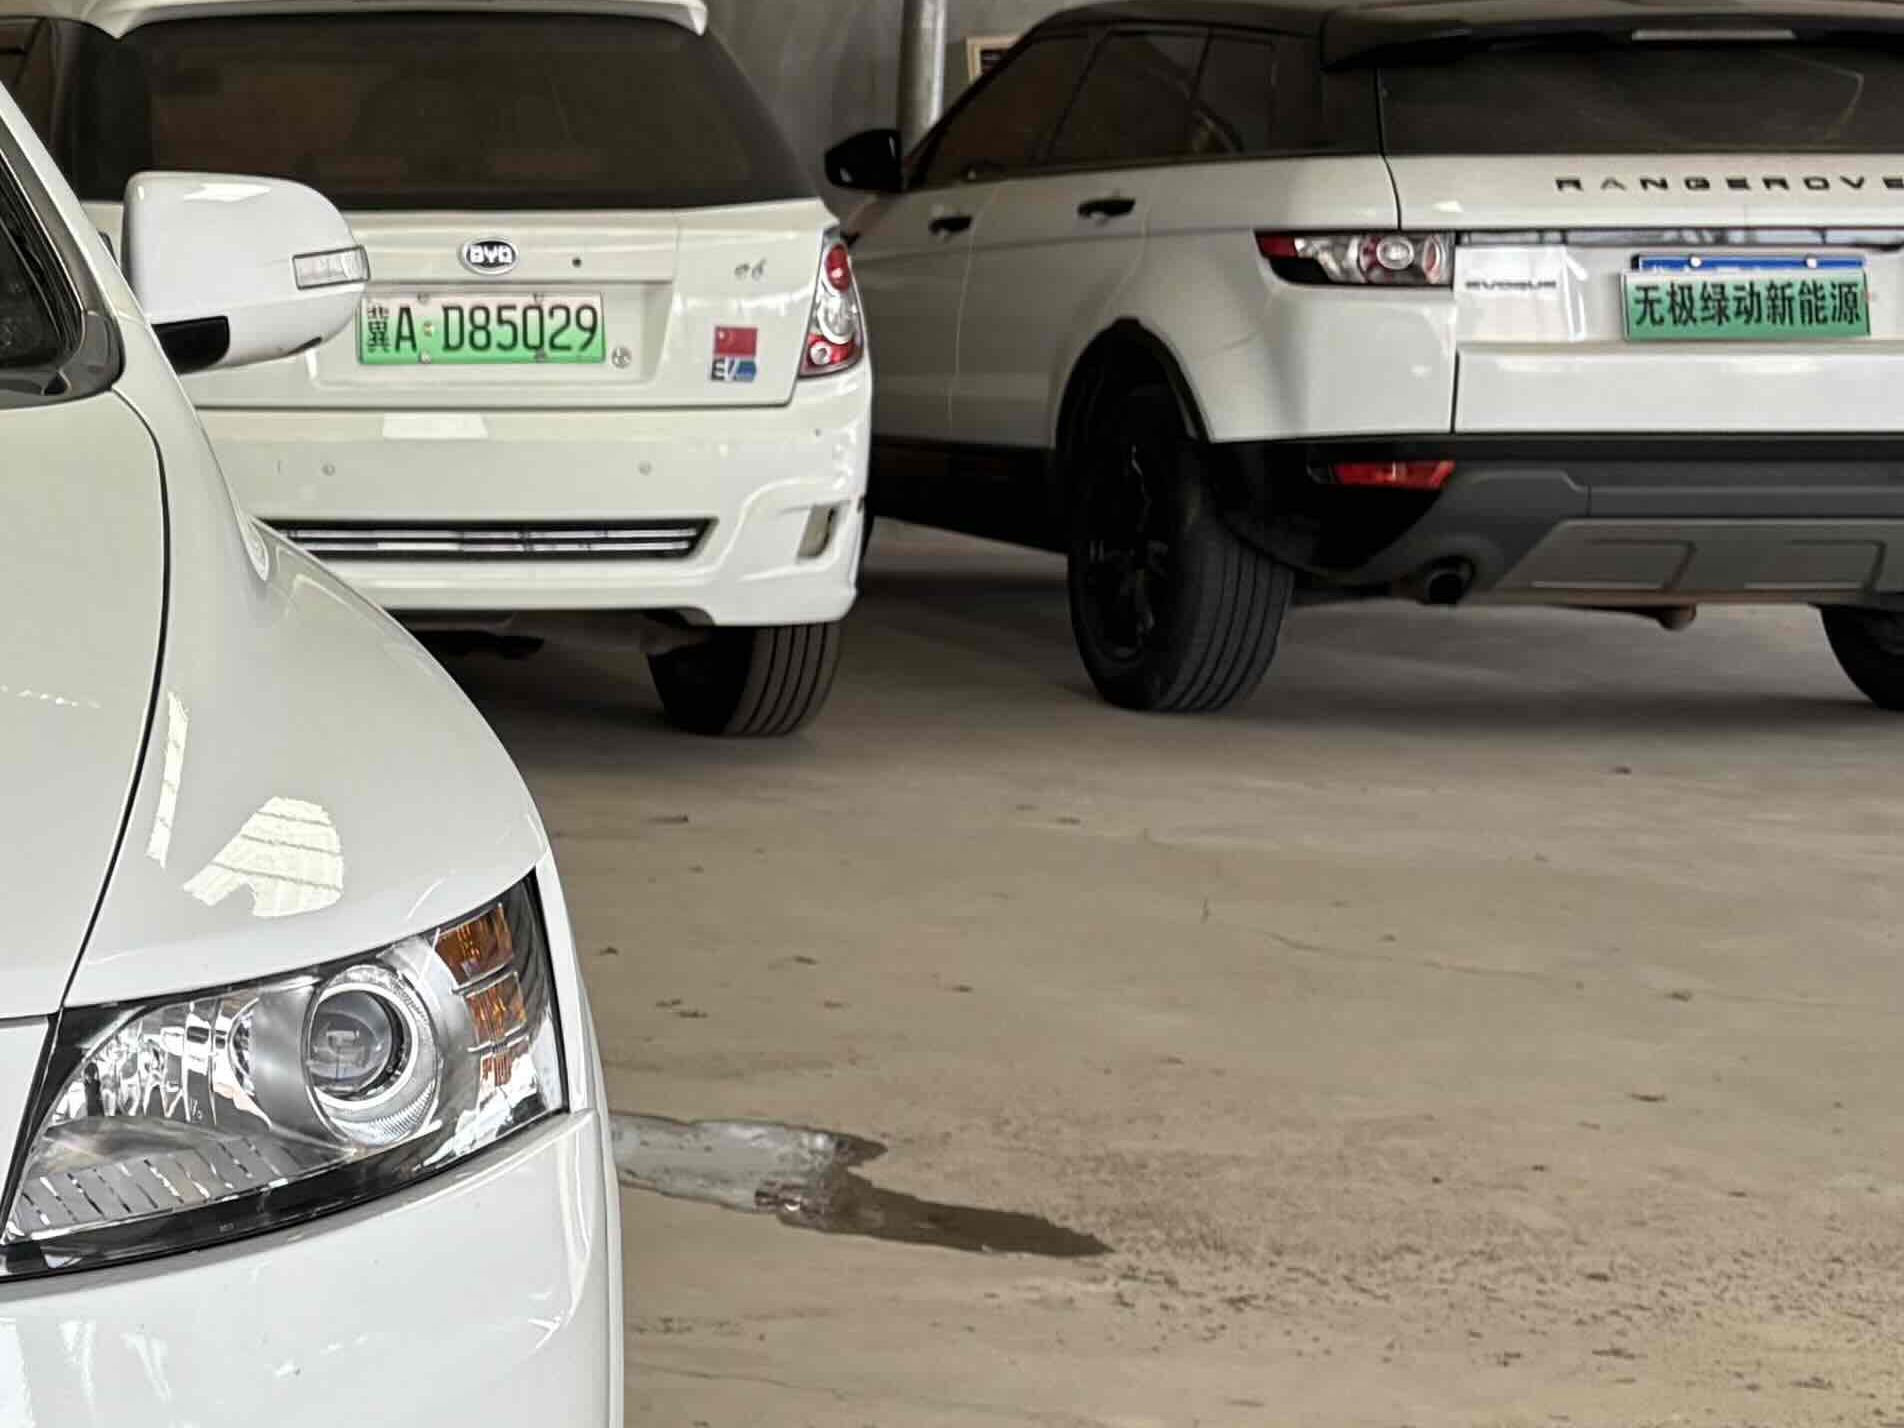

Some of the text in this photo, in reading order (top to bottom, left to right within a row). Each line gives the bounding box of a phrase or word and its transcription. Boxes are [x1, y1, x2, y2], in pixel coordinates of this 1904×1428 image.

[468, 245, 513, 263] BYD
[1634, 280, 1862, 326] 无极绿动新能源
